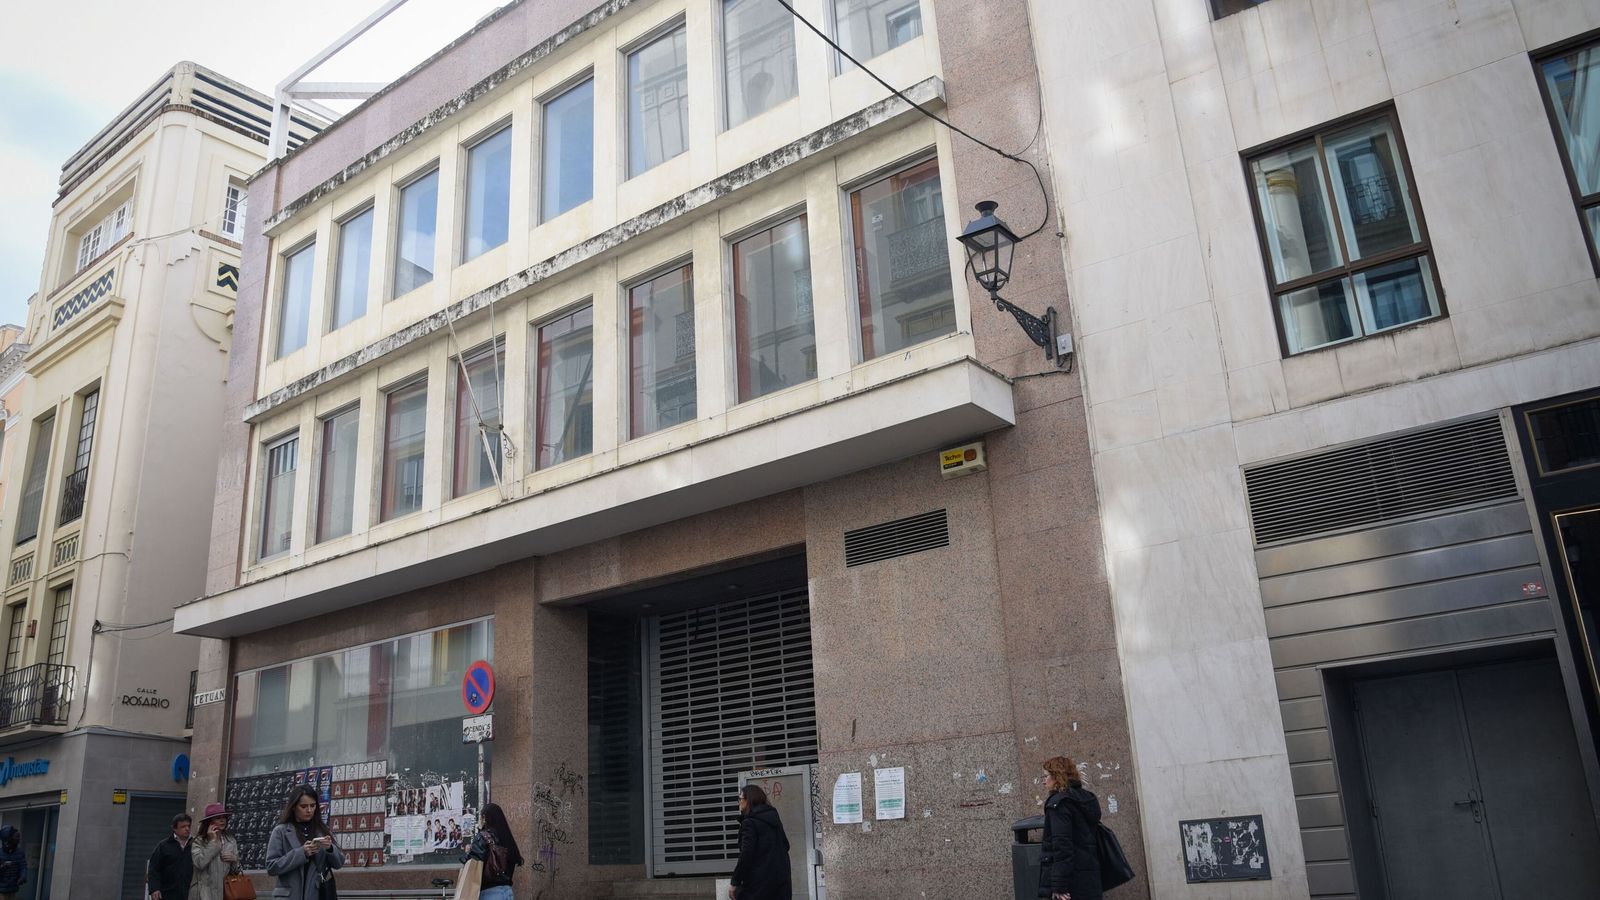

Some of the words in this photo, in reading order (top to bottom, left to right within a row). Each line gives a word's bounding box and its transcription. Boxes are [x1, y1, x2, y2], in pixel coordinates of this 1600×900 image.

[136, 687, 157, 695] CALLE
[195, 689, 225, 705] TETUAN
[121, 695, 170, 709] ROSARIO
